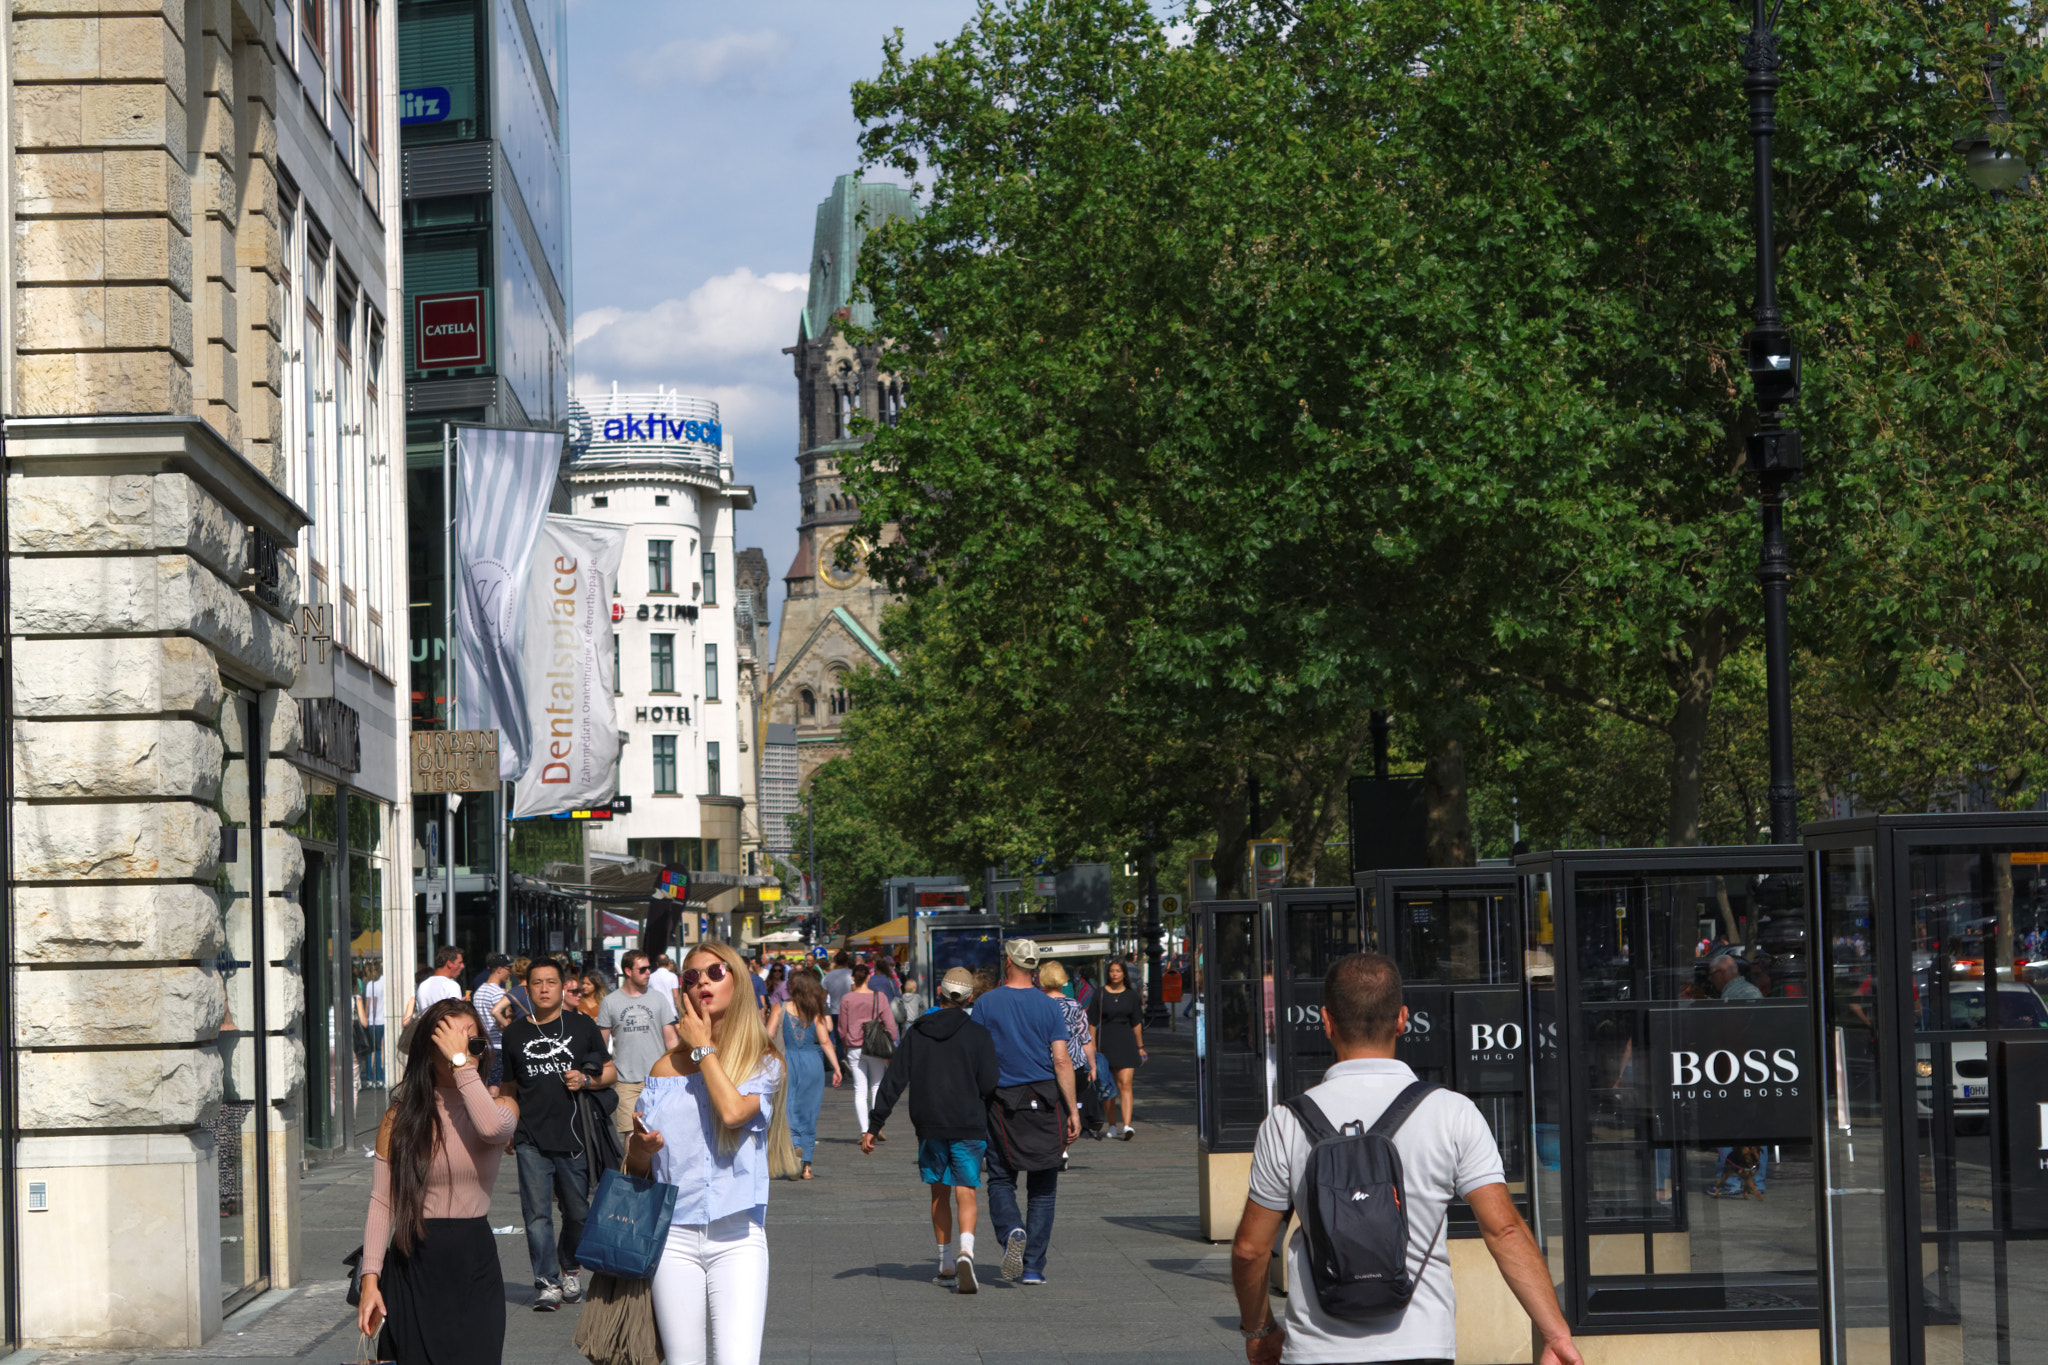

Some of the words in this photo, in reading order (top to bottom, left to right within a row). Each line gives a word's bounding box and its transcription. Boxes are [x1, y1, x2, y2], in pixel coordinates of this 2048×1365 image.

[425, 323, 475, 336] CATELLA
[542, 556, 580, 784] Dentalsplace
[636, 706, 692, 725] HOTEL
[418, 731, 494, 751] URBAN
[418, 750, 497, 770] OUTFIT
[419, 771, 470, 791] TERS
[1472, 1053, 1514, 1061] HUGO
[1670, 1048, 1800, 1086] BOSS
[1672, 1089, 1728, 1100] HUGO
[1743, 1087, 1799, 1098] BOSS
[1970, 1086, 1986, 1096] OHV
[608, 1213, 635, 1225] ZARA
